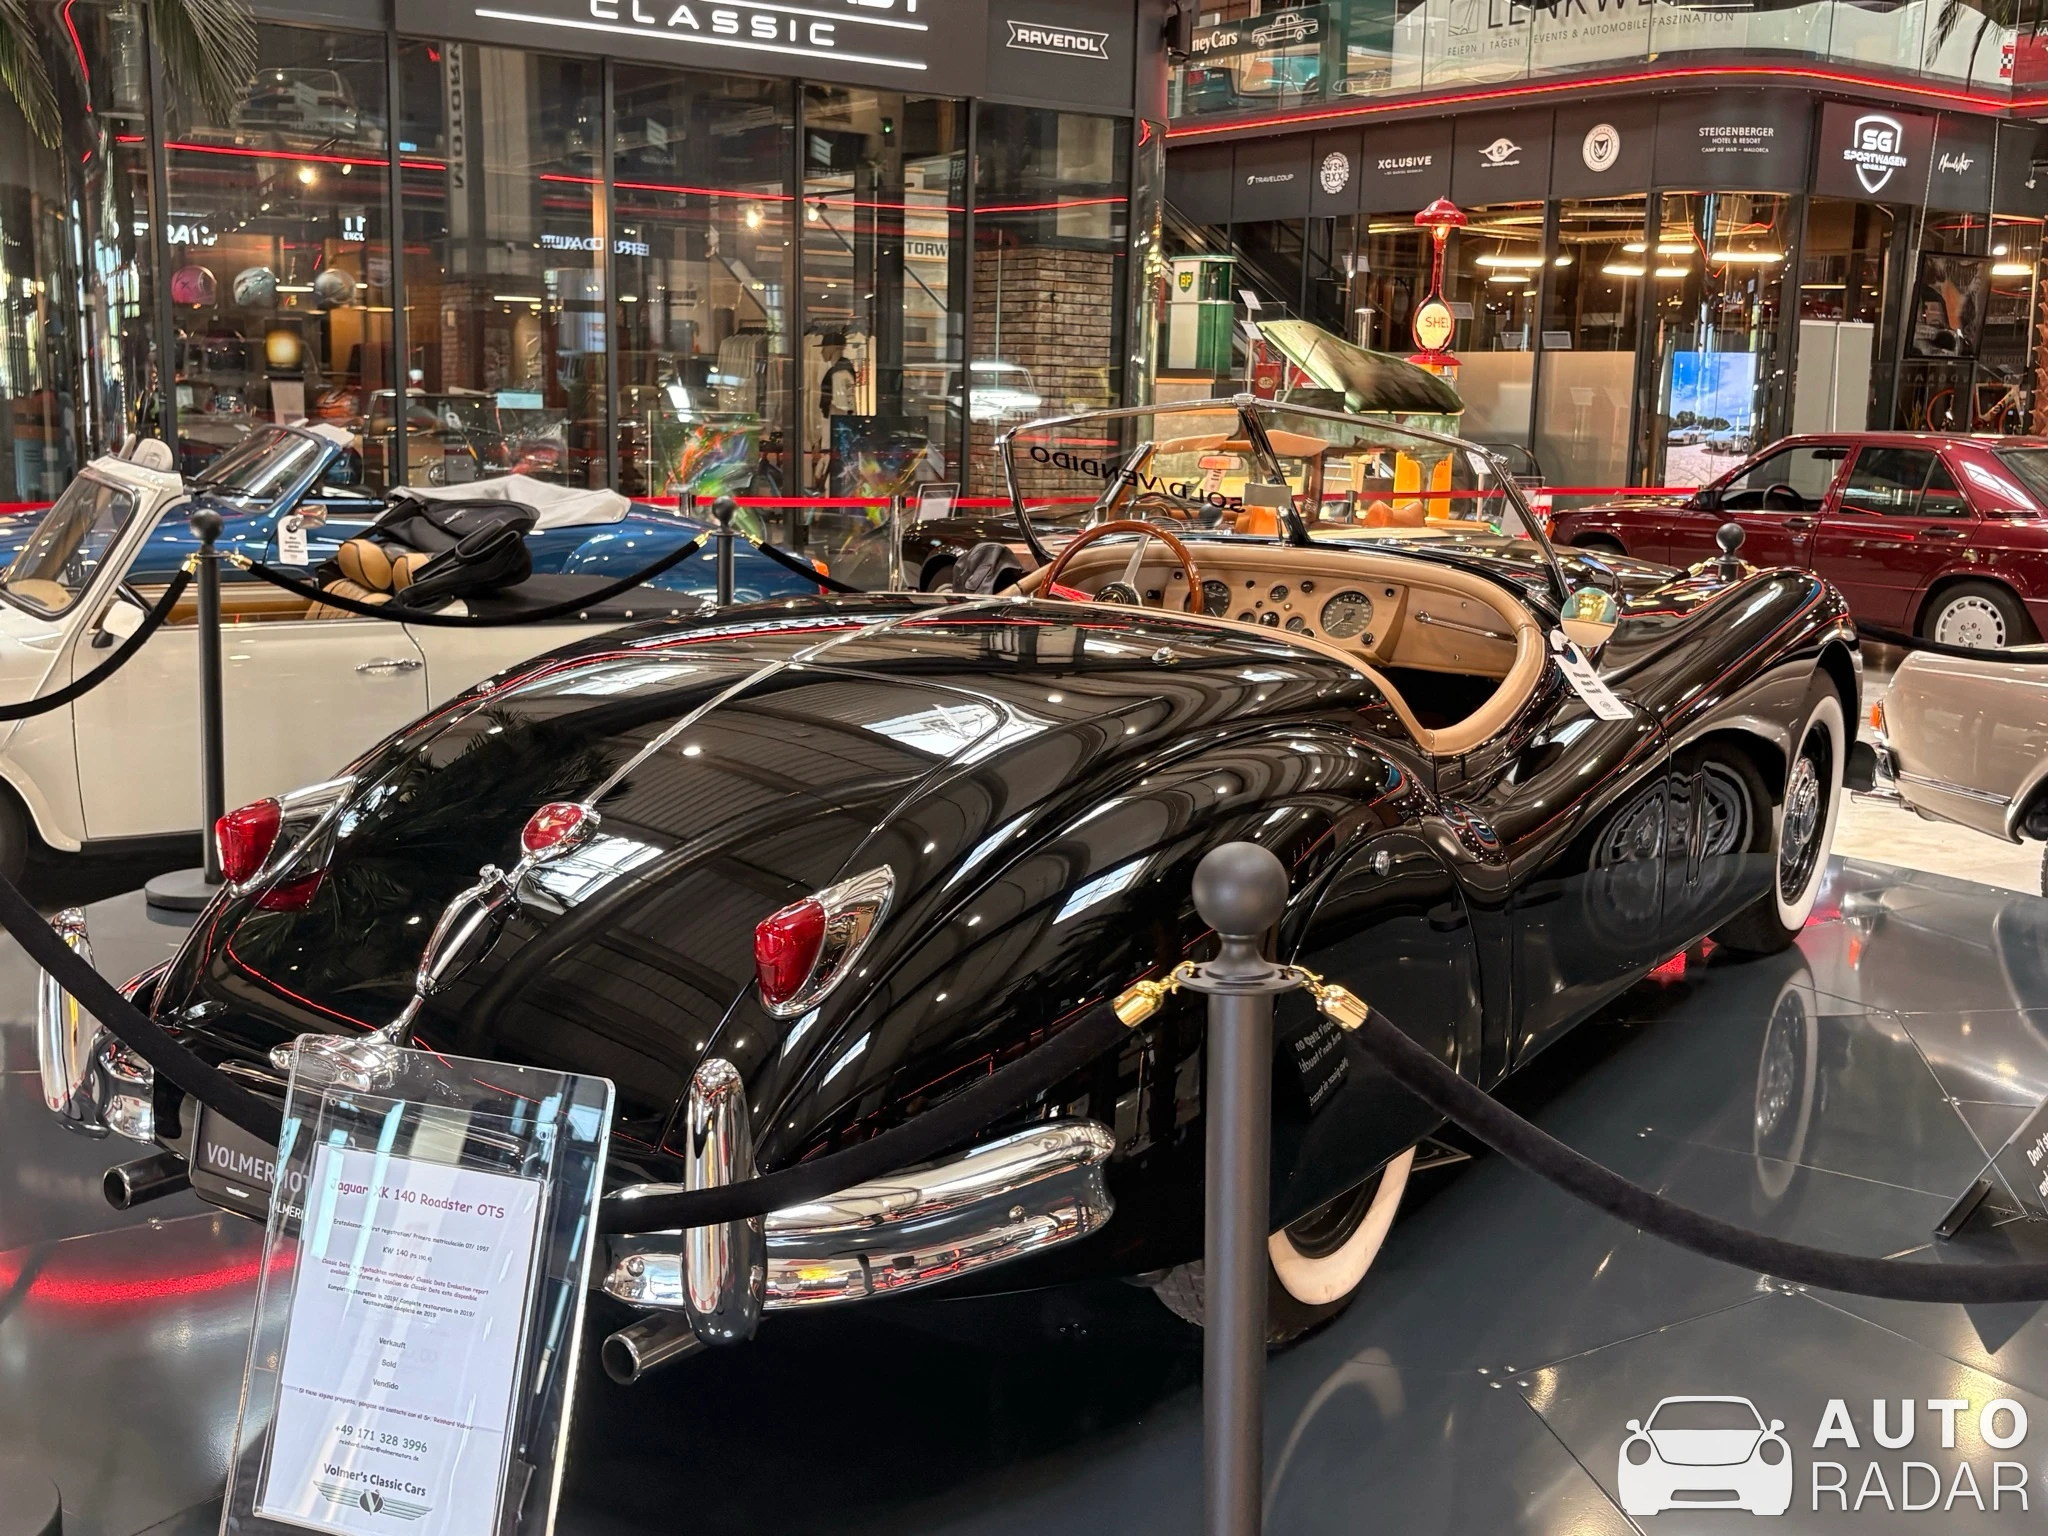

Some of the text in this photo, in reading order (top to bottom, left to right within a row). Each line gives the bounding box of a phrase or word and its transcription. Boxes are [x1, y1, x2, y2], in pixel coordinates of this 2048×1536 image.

[589, 0, 836, 48] CLASSIC
[1016, 28, 1099, 52] RAVENOL
[1447, 44, 1477, 57] FEIERN
[1490, 38, 1520, 50] TAGEN
[1533, 30, 1568, 44] EVENTS
[1582, 18, 1647, 36] AUTOMOBILE
[1652, 12, 1734, 27] FASZINATION
[1698, 127, 1774, 137] STEIGENBERGER
[1861, 129, 1893, 153] SG
[1377, 155, 1432, 169] XCLUSIVE
[1843, 149, 1907, 168] SPORTWAGEN
[1180, 274, 1192, 288] BP
[207, 1142, 310, 1193] VOLMEROT
[331, 1178, 505, 1219] Jaguar XK 140 Roadster OTS
[382, 1246, 394, 1255] KW
[396, 1248, 408, 1258] 140
[476, 1244, 489, 1252] 1957
[379, 1337, 406, 1349] Verkauft
[381, 1359, 397, 1369] Sold
[372, 1378, 399, 1390] Vendido
[335, 1424, 428, 1453] +49 171 328 3996
[323, 1463, 426, 1497] Volmer's Classic Cars
